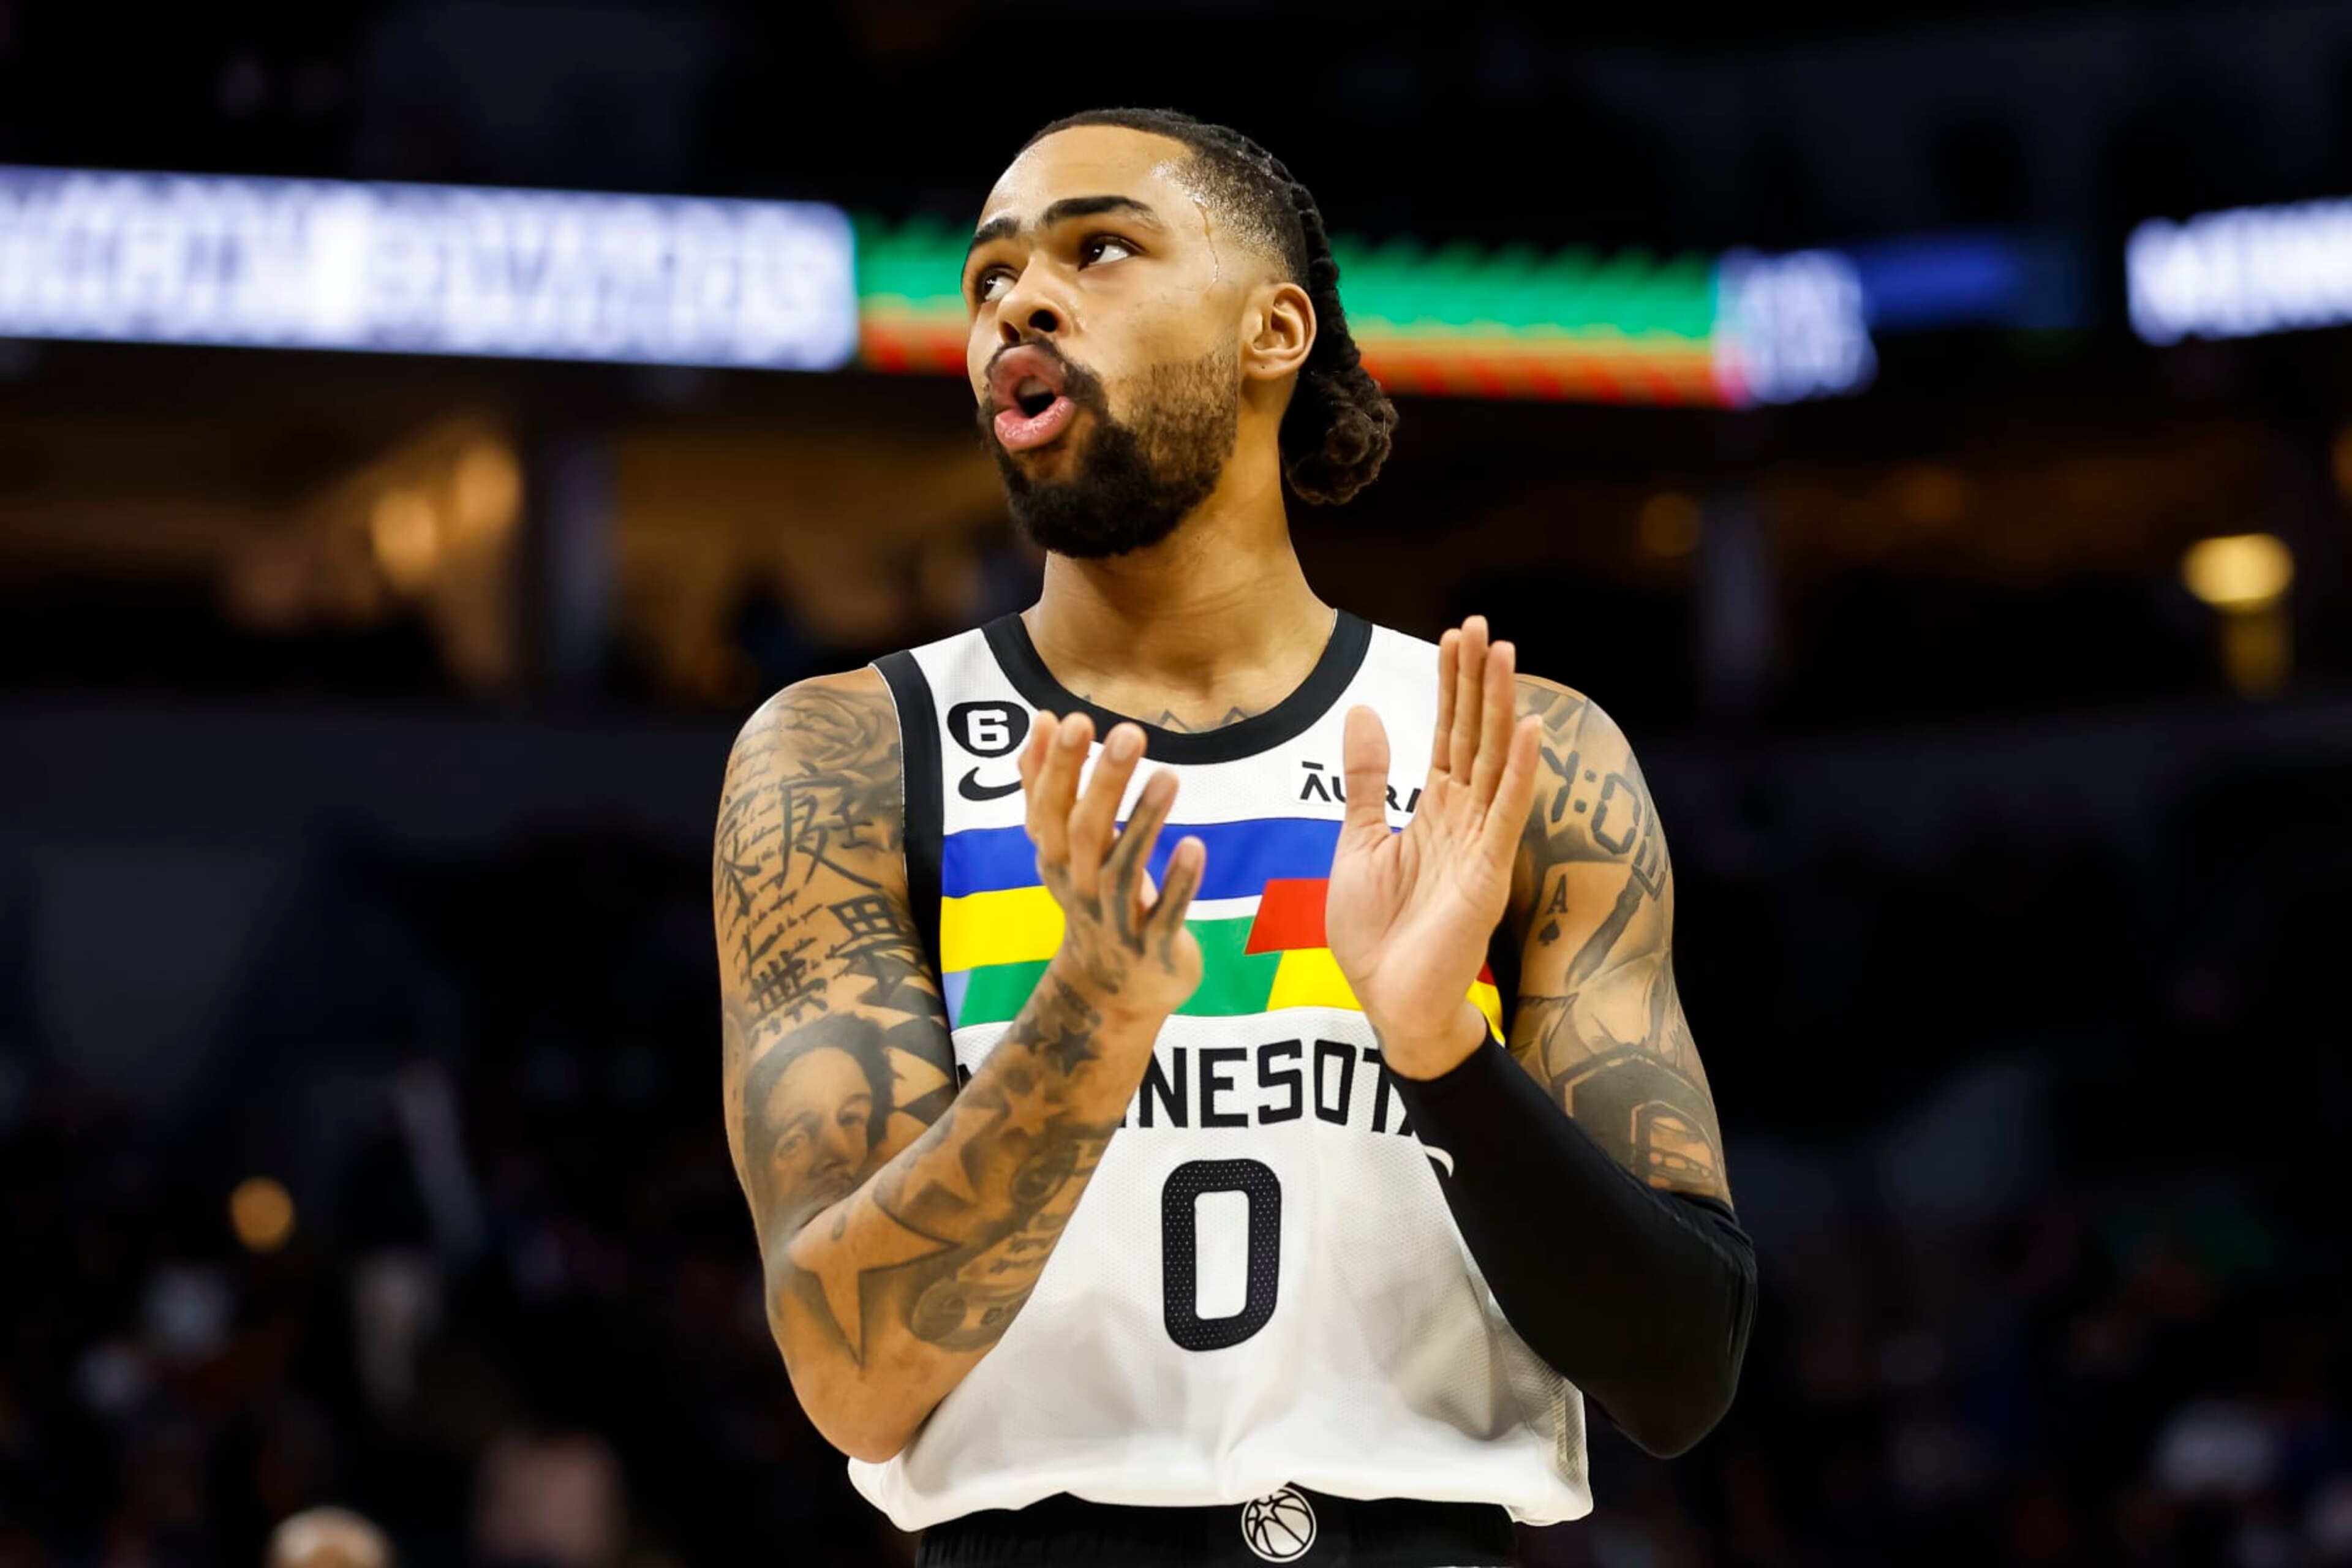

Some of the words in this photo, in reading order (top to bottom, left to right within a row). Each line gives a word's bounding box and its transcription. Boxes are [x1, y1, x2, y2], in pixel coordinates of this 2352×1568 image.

[967, 709, 1009, 750] 6
[1547, 874, 1568, 914] A
[1161, 1159, 1281, 1352] 0
